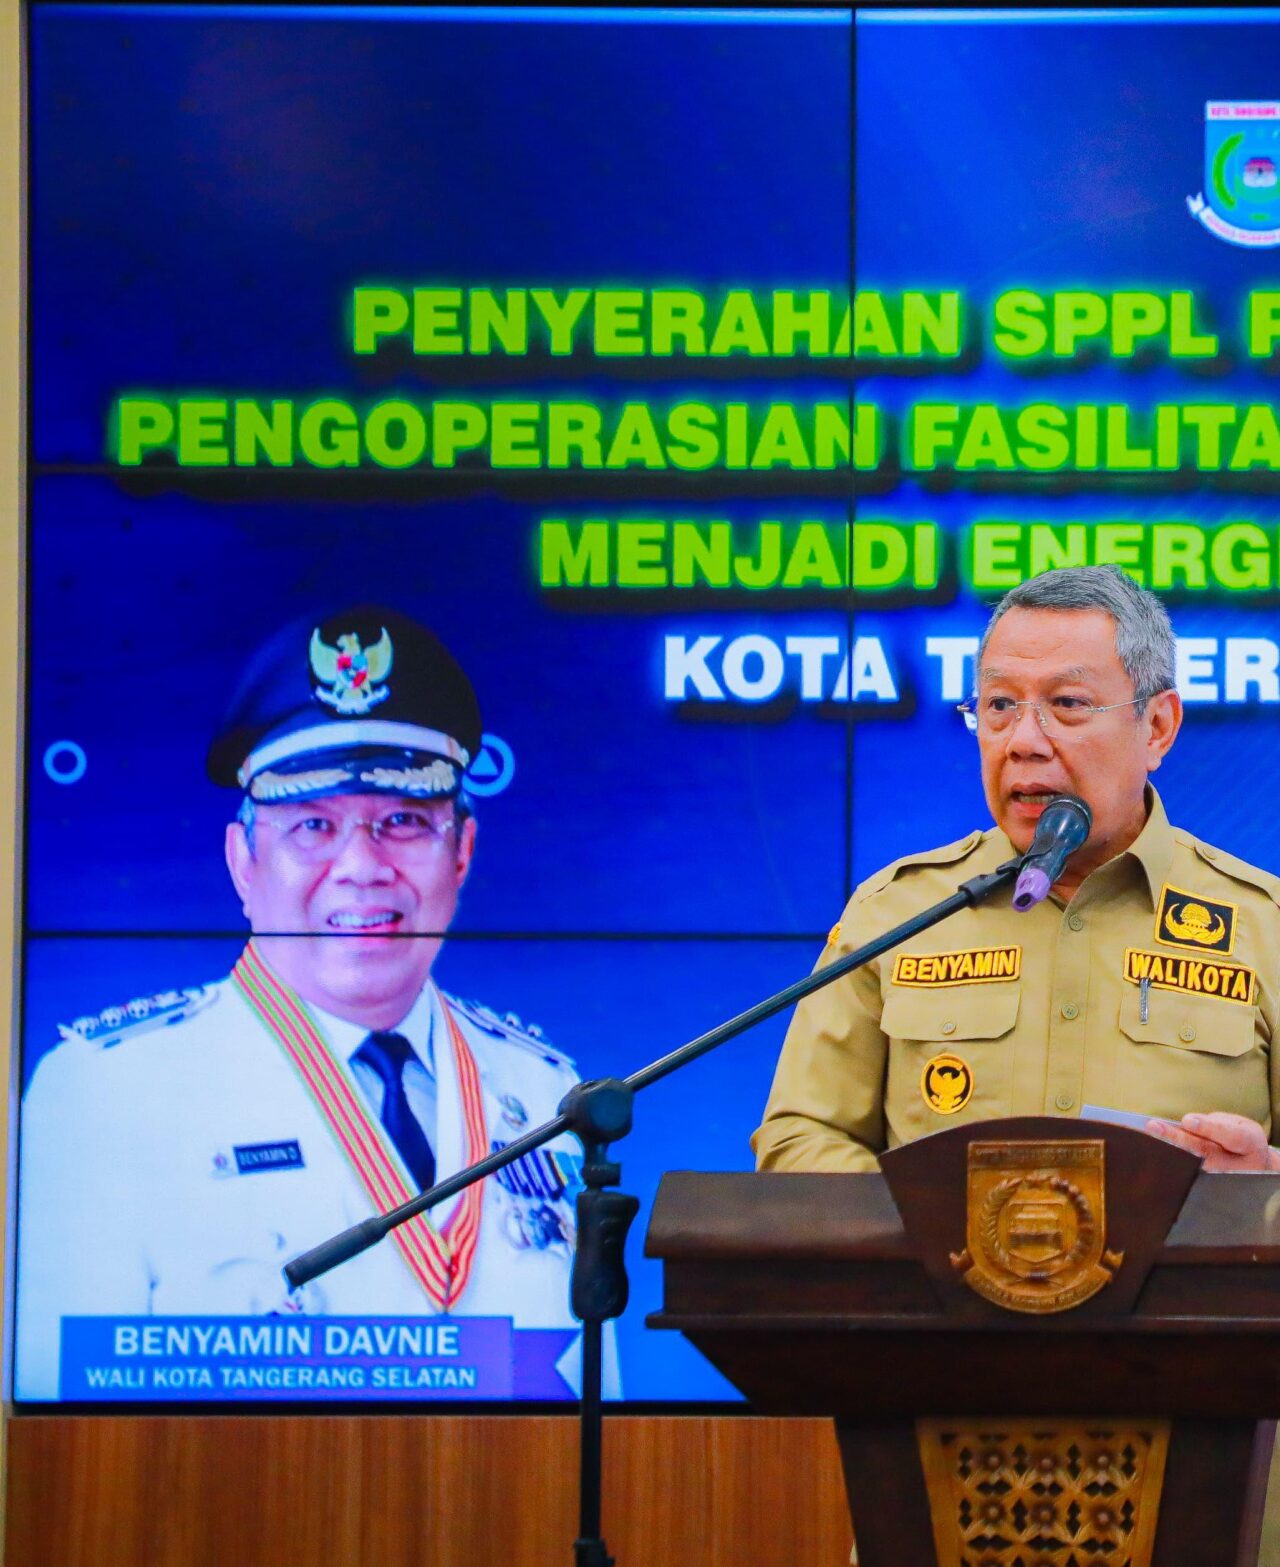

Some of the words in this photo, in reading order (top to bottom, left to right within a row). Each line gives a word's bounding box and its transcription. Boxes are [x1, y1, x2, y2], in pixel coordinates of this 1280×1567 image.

[354, 289, 960, 355] PENYERAHAN
[993, 290, 1217, 357] SPPL
[119, 401, 877, 470] PENGOPERASIAN
[540, 522, 937, 588] MENJADI
[663, 634, 897, 701] KOTA
[900, 950, 1016, 981] BENYAMIN
[1131, 953, 1248, 1000] WALIKOTA
[115, 1326, 311, 1356] BENYAMIN
[324, 1326, 459, 1356] DAVNIE
[85, 1367, 145, 1388] WALI
[152, 1367, 214, 1388] KOTA
[219, 1367, 365, 1388] TANGERANG
[371, 1367, 476, 1388] SELATAN
